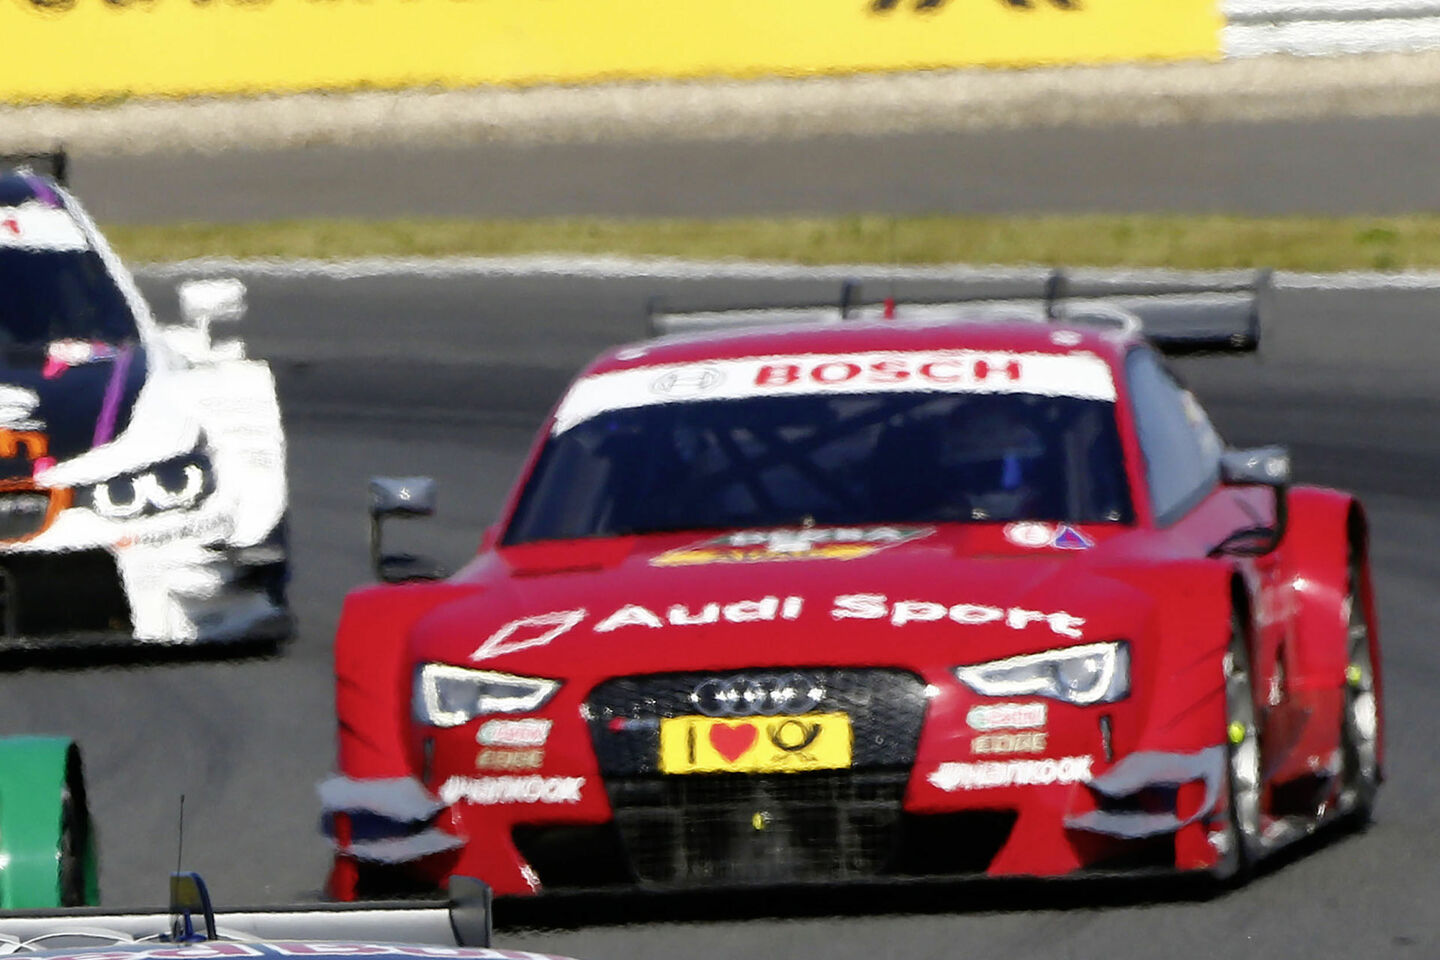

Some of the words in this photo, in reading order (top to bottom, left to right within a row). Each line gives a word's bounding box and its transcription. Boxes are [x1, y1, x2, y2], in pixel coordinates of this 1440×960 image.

[754, 358, 1022, 388] BOSCH
[593, 595, 804, 632] Audi
[830, 593, 1086, 639] Sport
[687, 726, 697, 765] I
